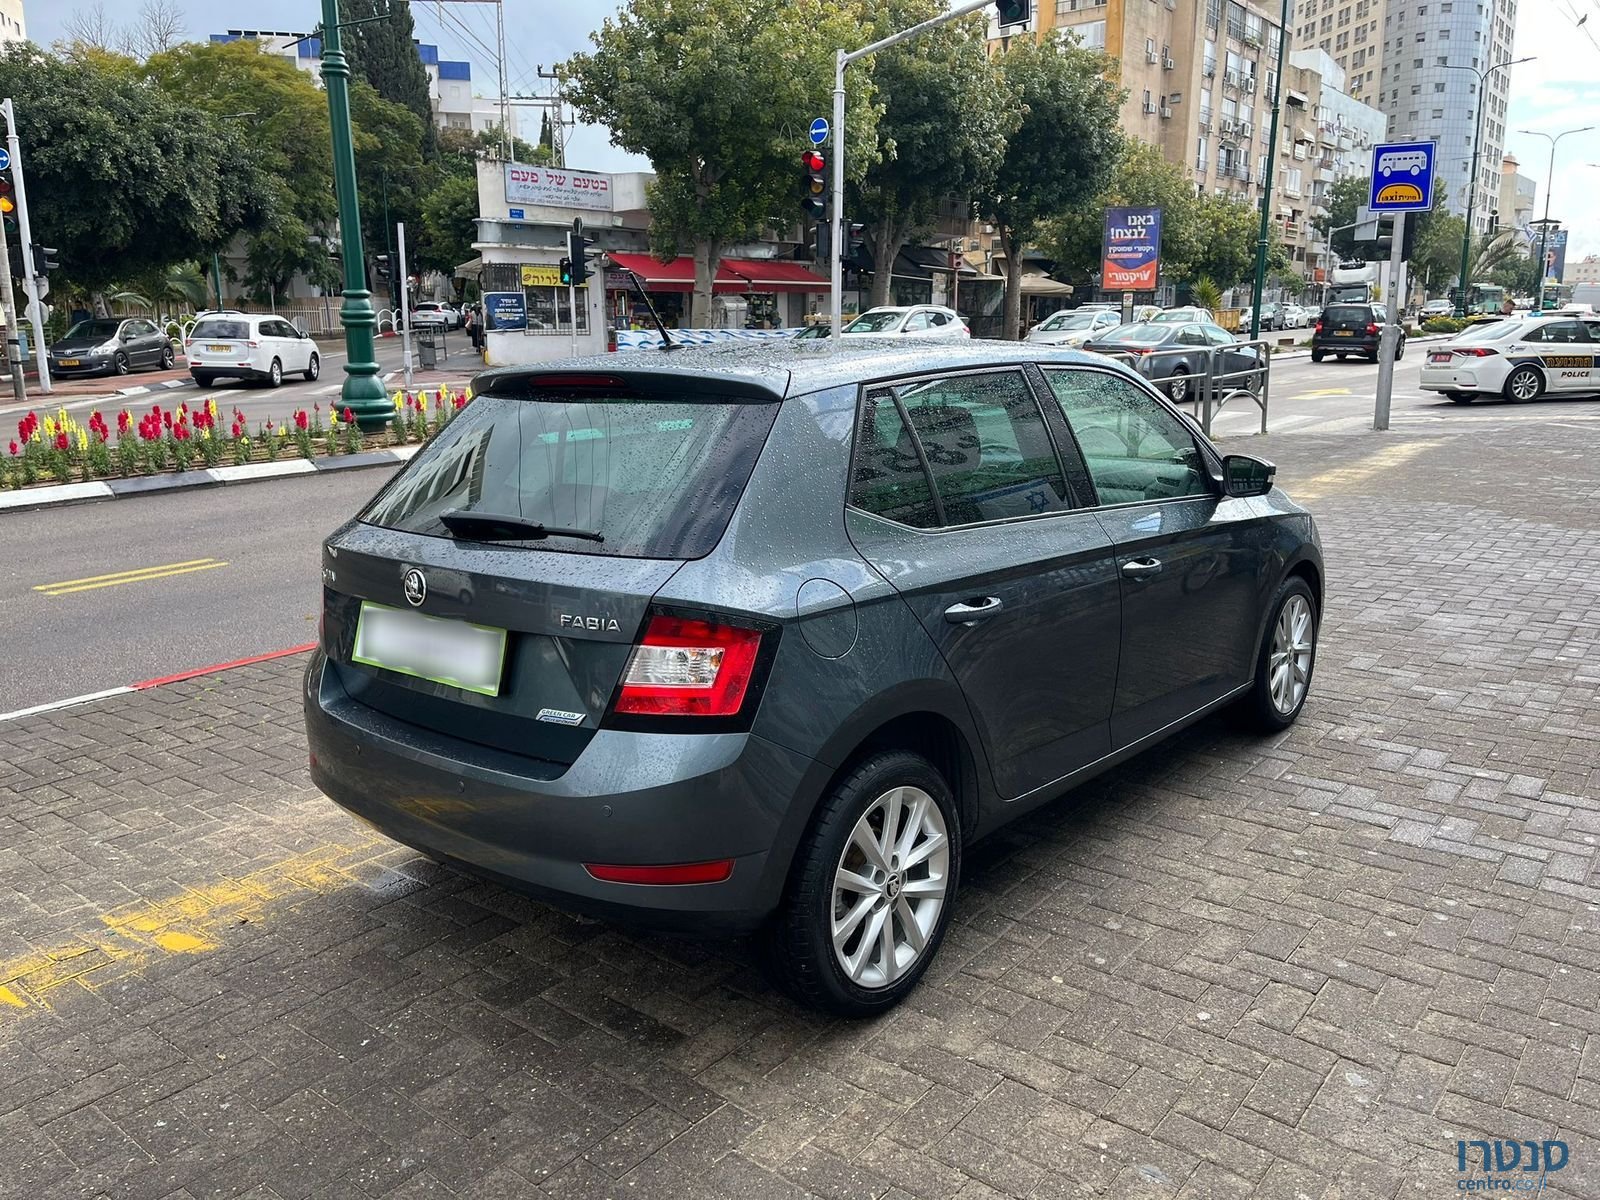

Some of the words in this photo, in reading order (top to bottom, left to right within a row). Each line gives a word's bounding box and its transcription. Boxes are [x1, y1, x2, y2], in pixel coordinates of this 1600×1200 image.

[511, 169, 539, 183] פעם
[545, 170, 566, 186] של
[573, 176, 608, 191] בטעם
[1127, 215, 1155, 226] באנו
[1110, 226, 1146, 240] לנצח!
[1546, 357, 1592, 368] התנועה
[560, 614, 622, 632] FABIA
[541, 709, 562, 717] GREEN
